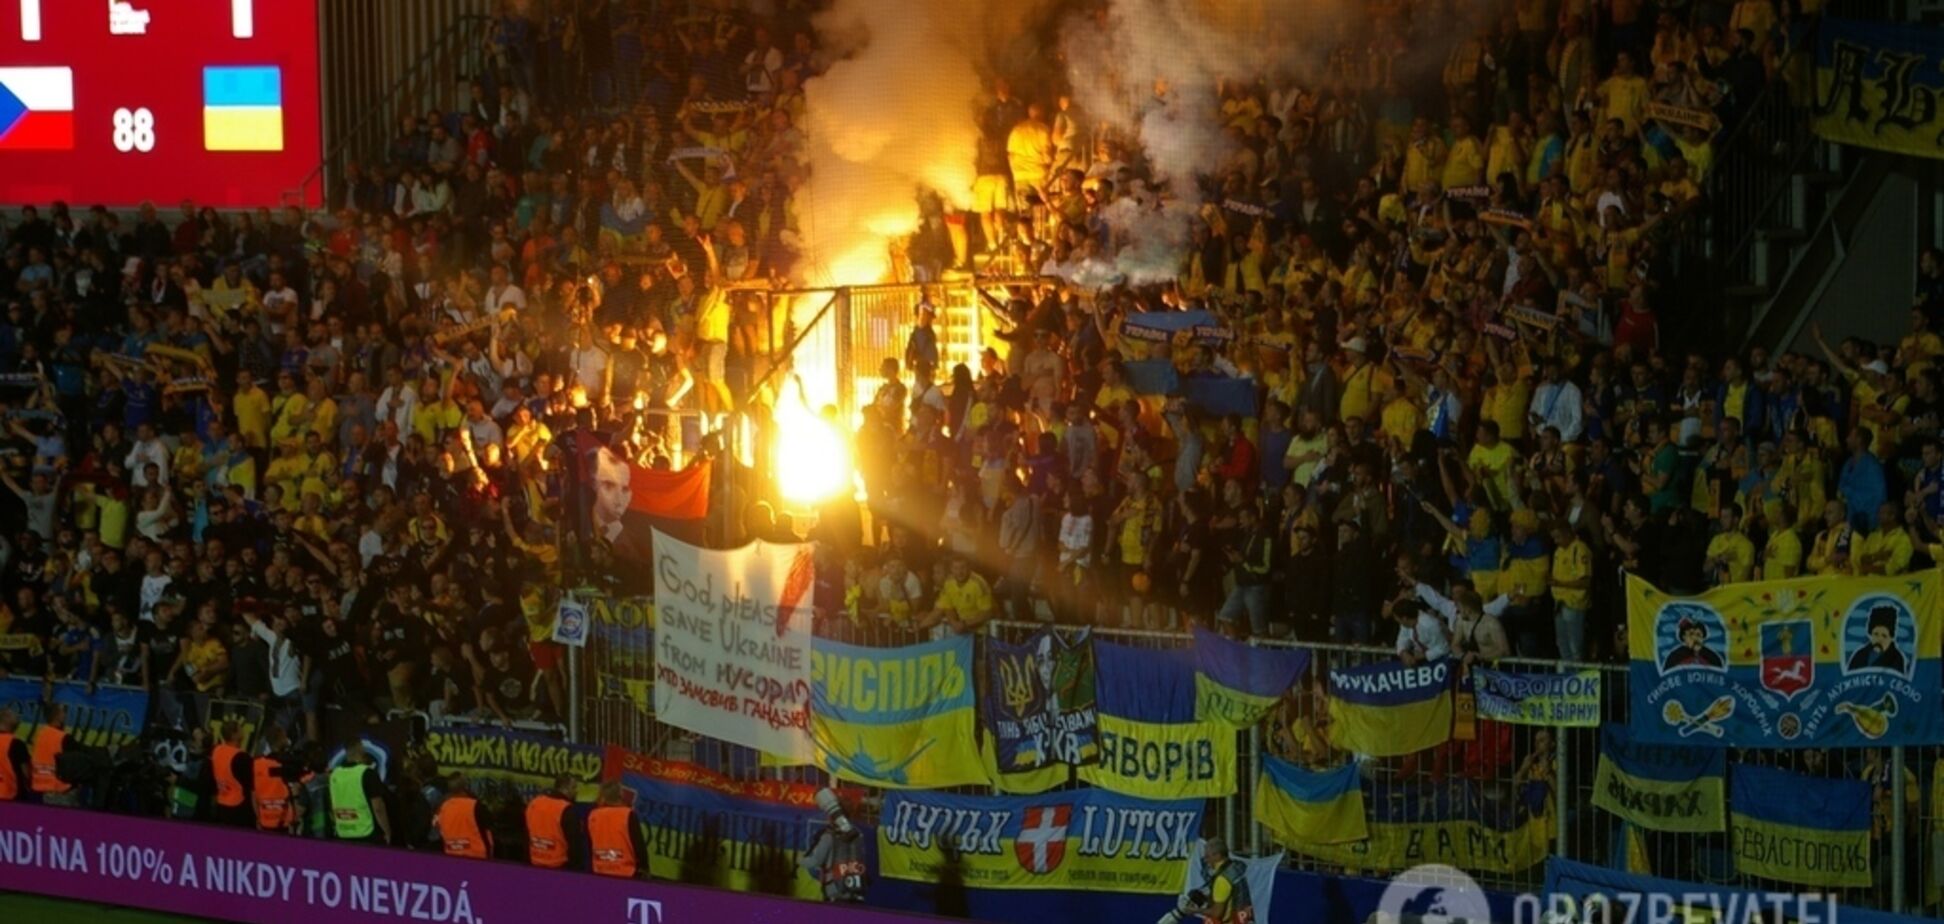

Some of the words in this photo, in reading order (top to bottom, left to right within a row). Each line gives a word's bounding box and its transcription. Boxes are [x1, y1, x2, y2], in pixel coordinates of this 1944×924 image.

[112, 107, 155, 153] 88
[661, 604, 712, 643] SAVE
[1329, 661, 1448, 694] МУКАЧЕВО
[1100, 731, 1215, 783] ЯВОРІВ
[885, 799, 1012, 856] ЛУЦЬК
[1077, 804, 1198, 861] LUTSK
[50, 835, 88, 874] NA
[96, 841, 174, 885] 100%
[179, 852, 199, 889] A
[206, 856, 296, 902] NIKDY
[302, 868, 342, 909] TO
